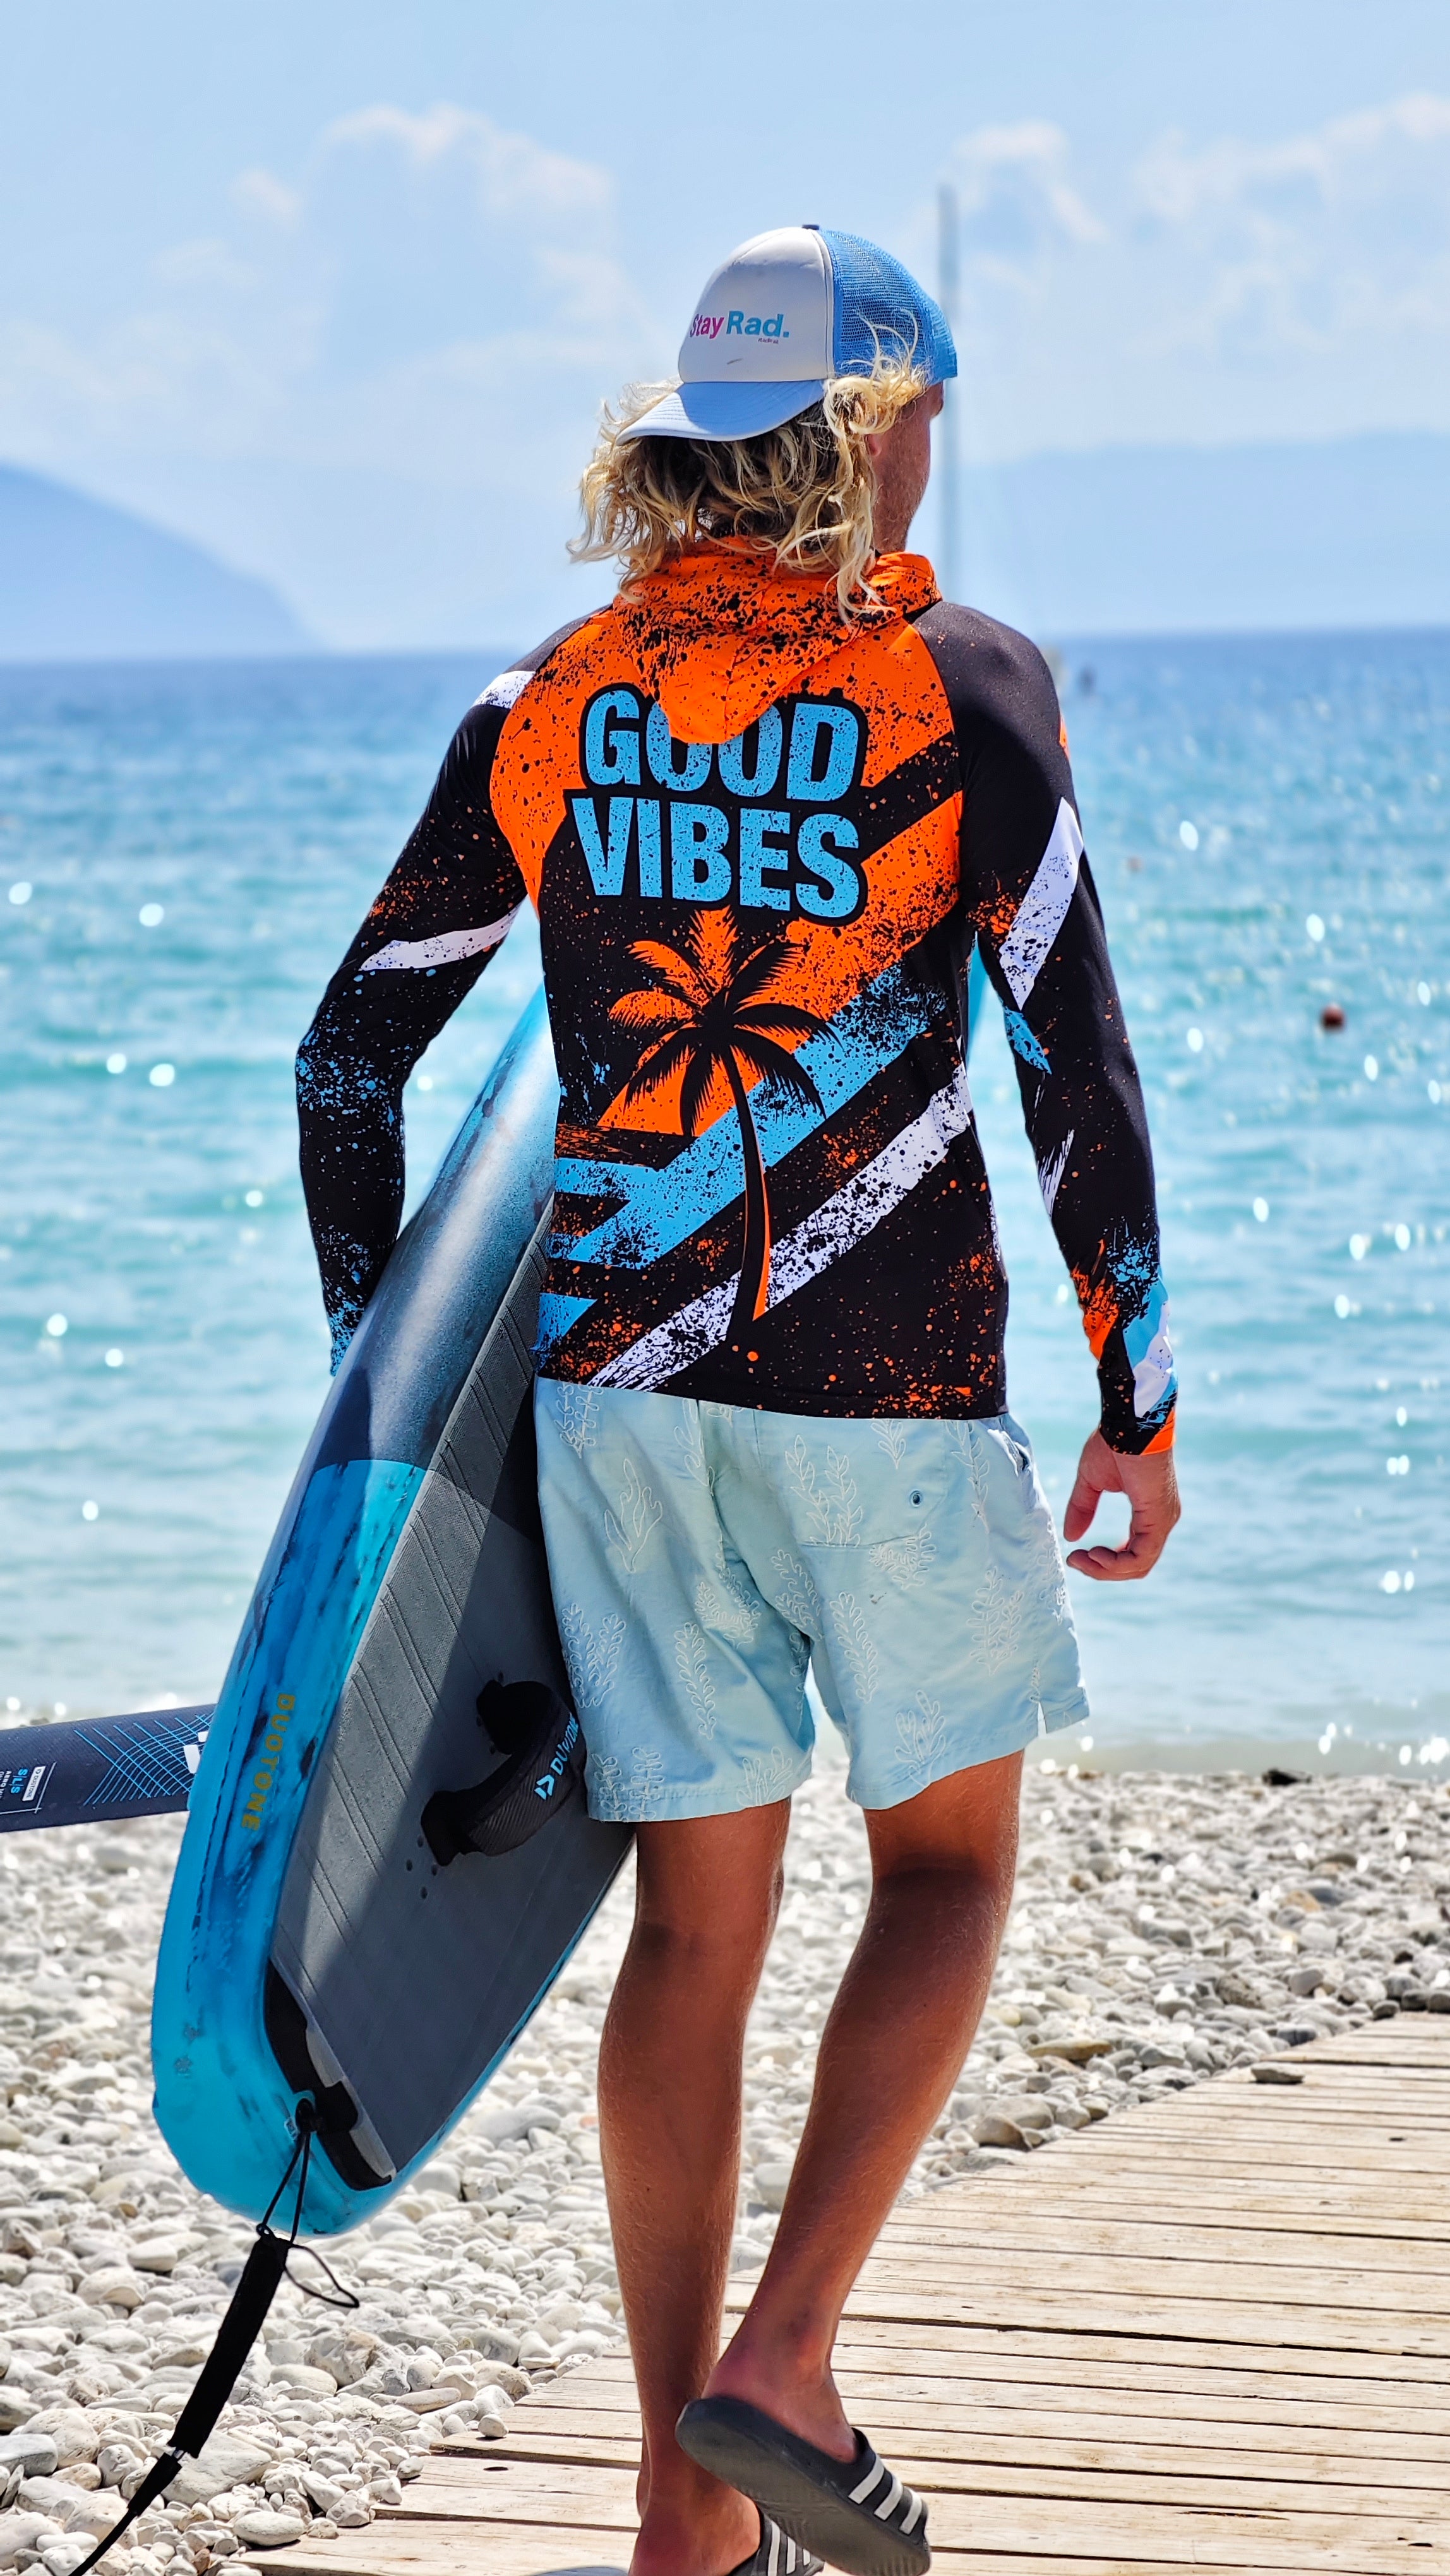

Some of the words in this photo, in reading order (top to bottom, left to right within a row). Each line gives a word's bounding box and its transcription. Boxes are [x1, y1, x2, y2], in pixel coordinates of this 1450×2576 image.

[690, 314, 724, 339] Stay
[726, 311, 789, 338] Rad.
[585, 689, 859, 801] GOOD
[571, 796, 860, 917] VIBES
[241, 1693, 296, 1831] DUOTONE
